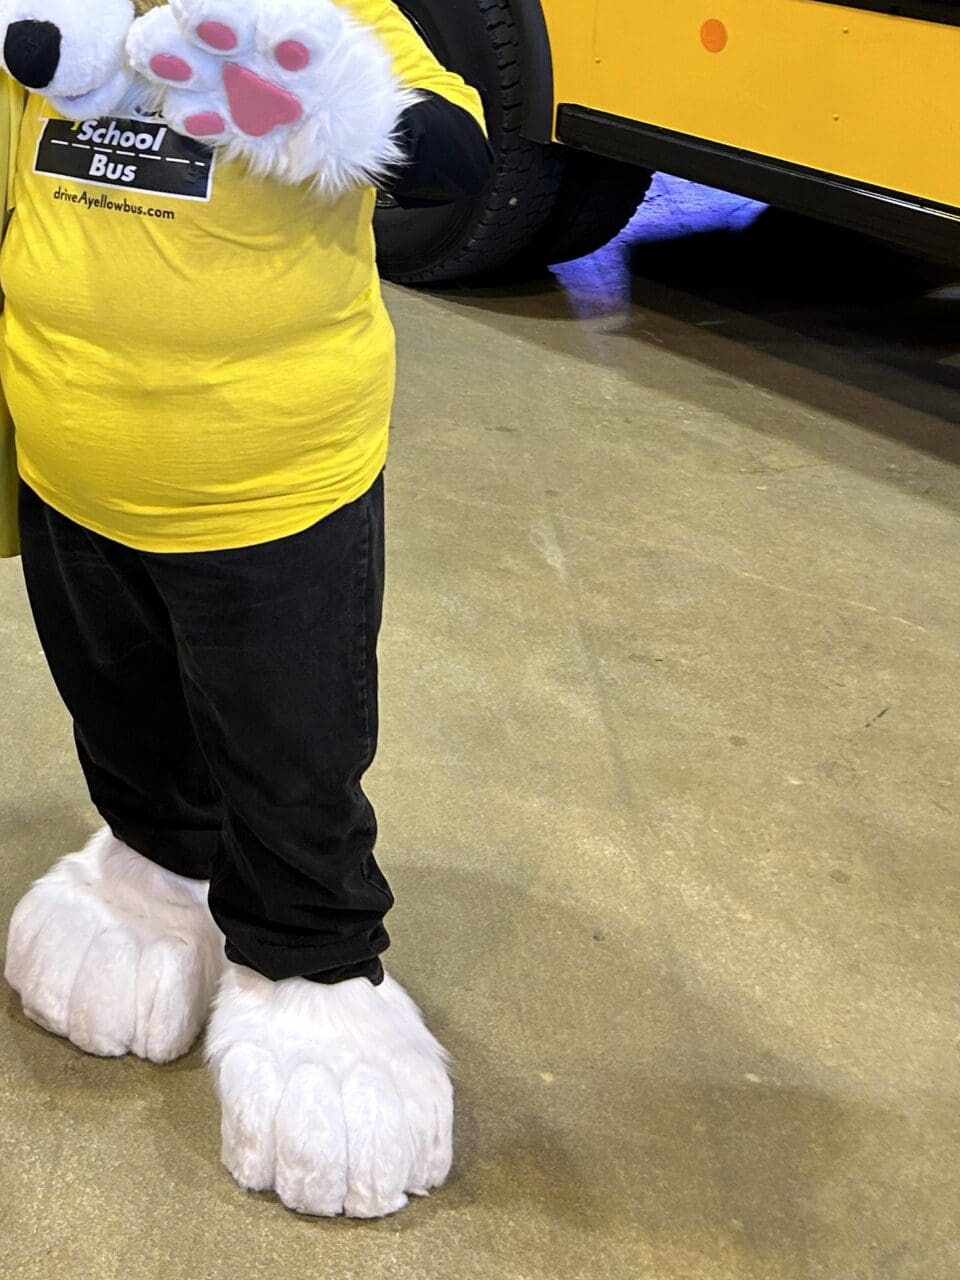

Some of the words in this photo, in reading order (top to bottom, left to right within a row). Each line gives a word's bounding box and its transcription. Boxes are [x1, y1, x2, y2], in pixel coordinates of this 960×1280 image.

[76, 119, 167, 152] School
[88, 153, 138, 183] Bus
[53, 186, 176, 220] driveAyellowbus.com
